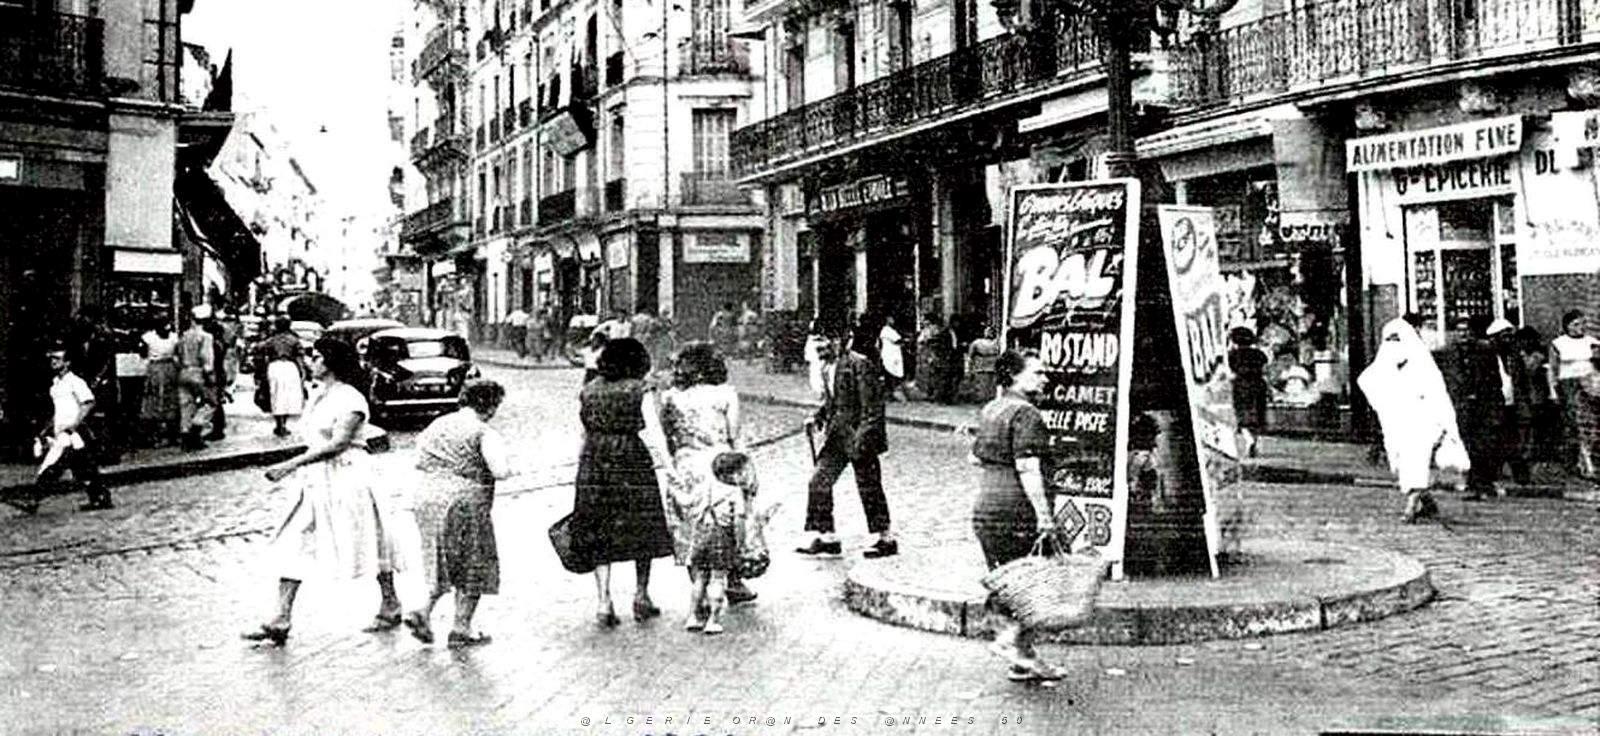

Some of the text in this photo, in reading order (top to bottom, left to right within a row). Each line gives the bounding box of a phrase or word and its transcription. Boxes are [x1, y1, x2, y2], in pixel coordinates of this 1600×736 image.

[1353, 123, 1517, 166] ALIMENTATION FINE
[1010, 245, 1115, 320] BAL
